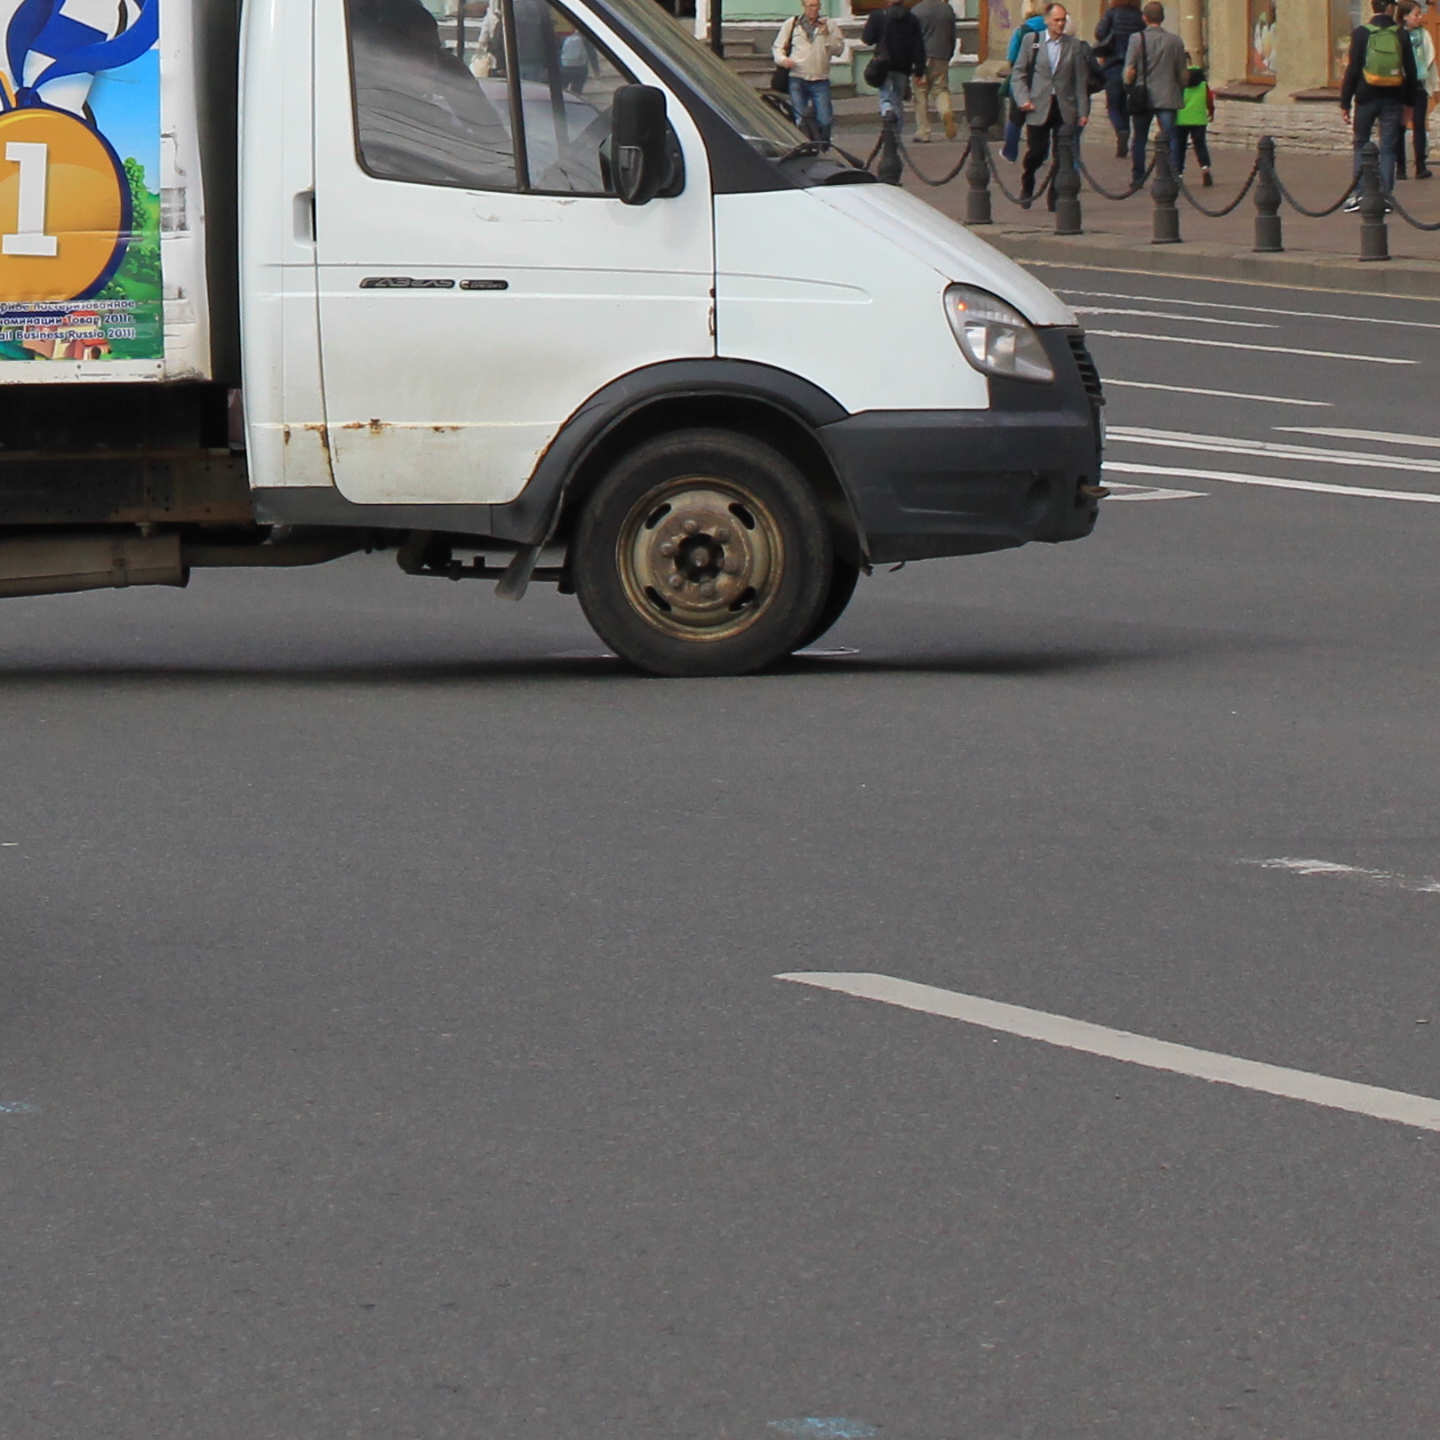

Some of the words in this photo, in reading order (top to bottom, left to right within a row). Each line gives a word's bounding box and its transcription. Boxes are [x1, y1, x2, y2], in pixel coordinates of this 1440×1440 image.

[1, 141, 58, 257] 1
[65, 315, 100, 328] Товар
[16, 330, 65, 341] Business
[69, 329, 105, 340] Russia
